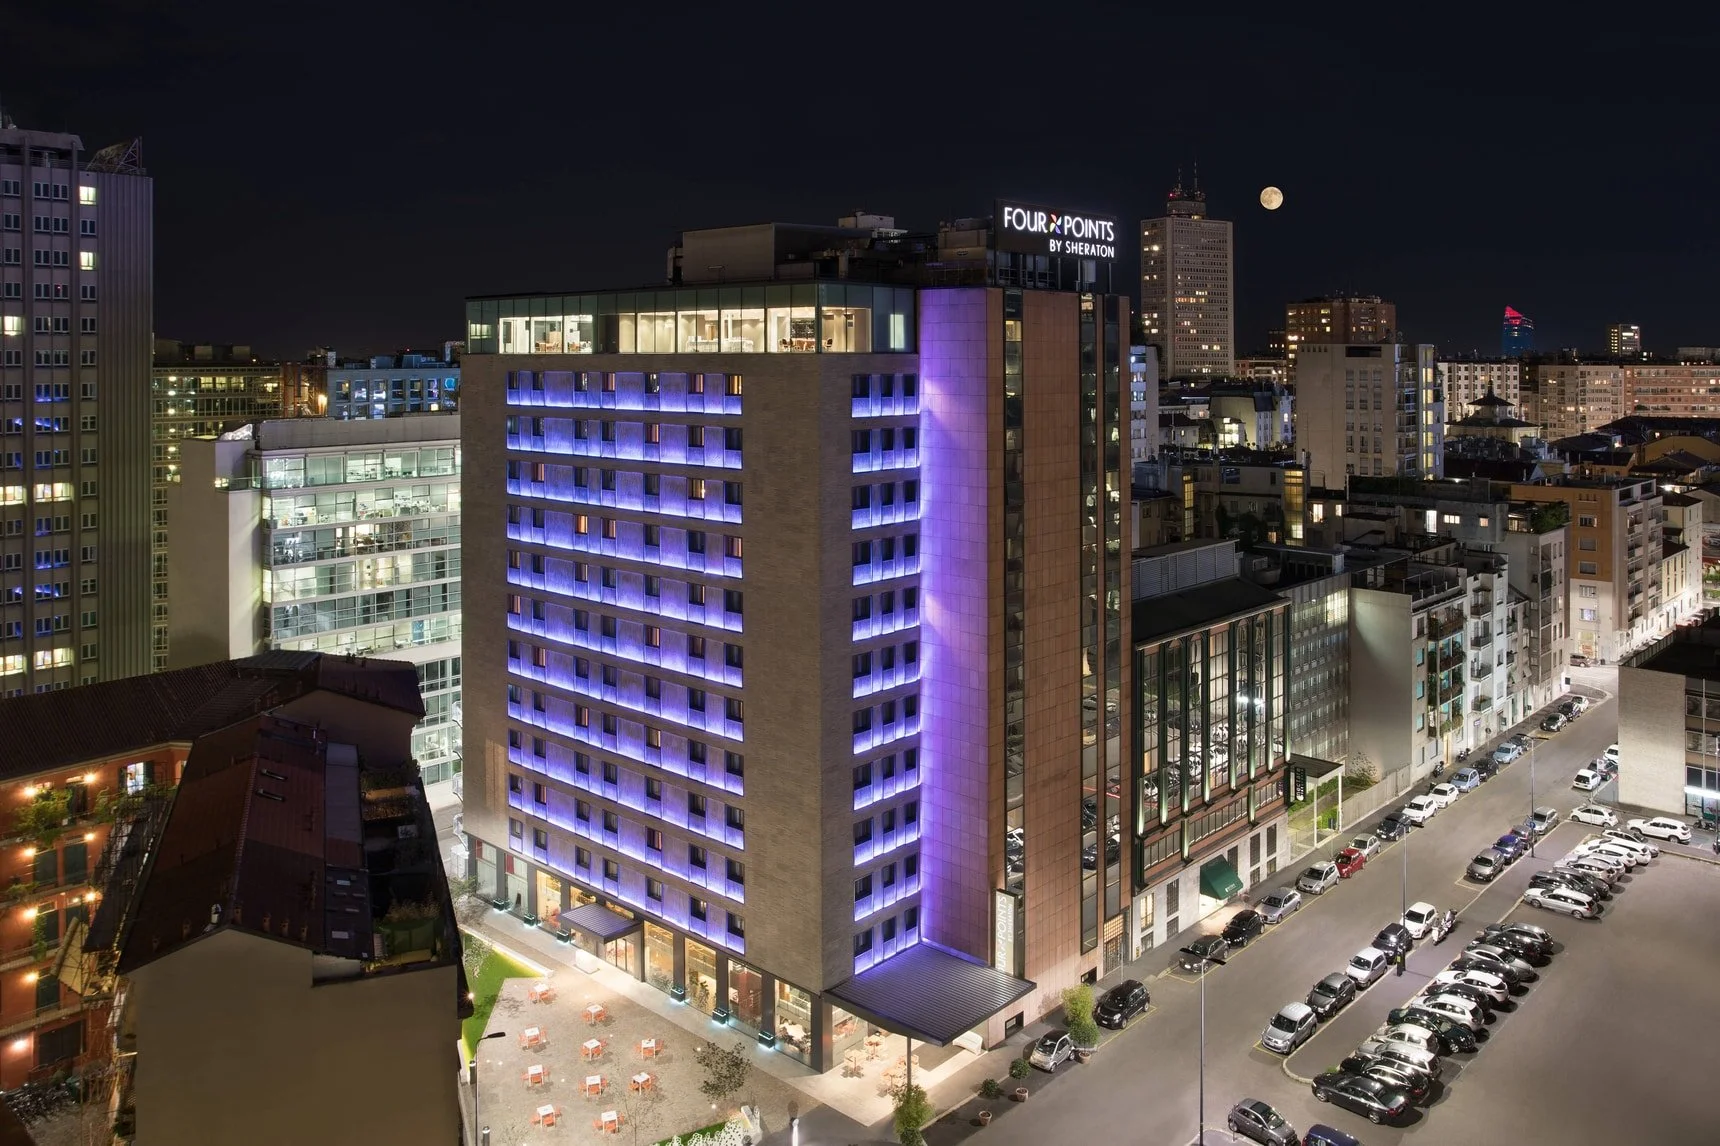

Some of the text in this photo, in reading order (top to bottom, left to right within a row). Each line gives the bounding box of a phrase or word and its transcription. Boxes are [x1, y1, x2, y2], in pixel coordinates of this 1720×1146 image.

[1004, 207, 1115, 242] FOUR POINTS
[1049, 239, 1115, 258] BY SHERATON
[997, 896, 1007, 940] POINTS
